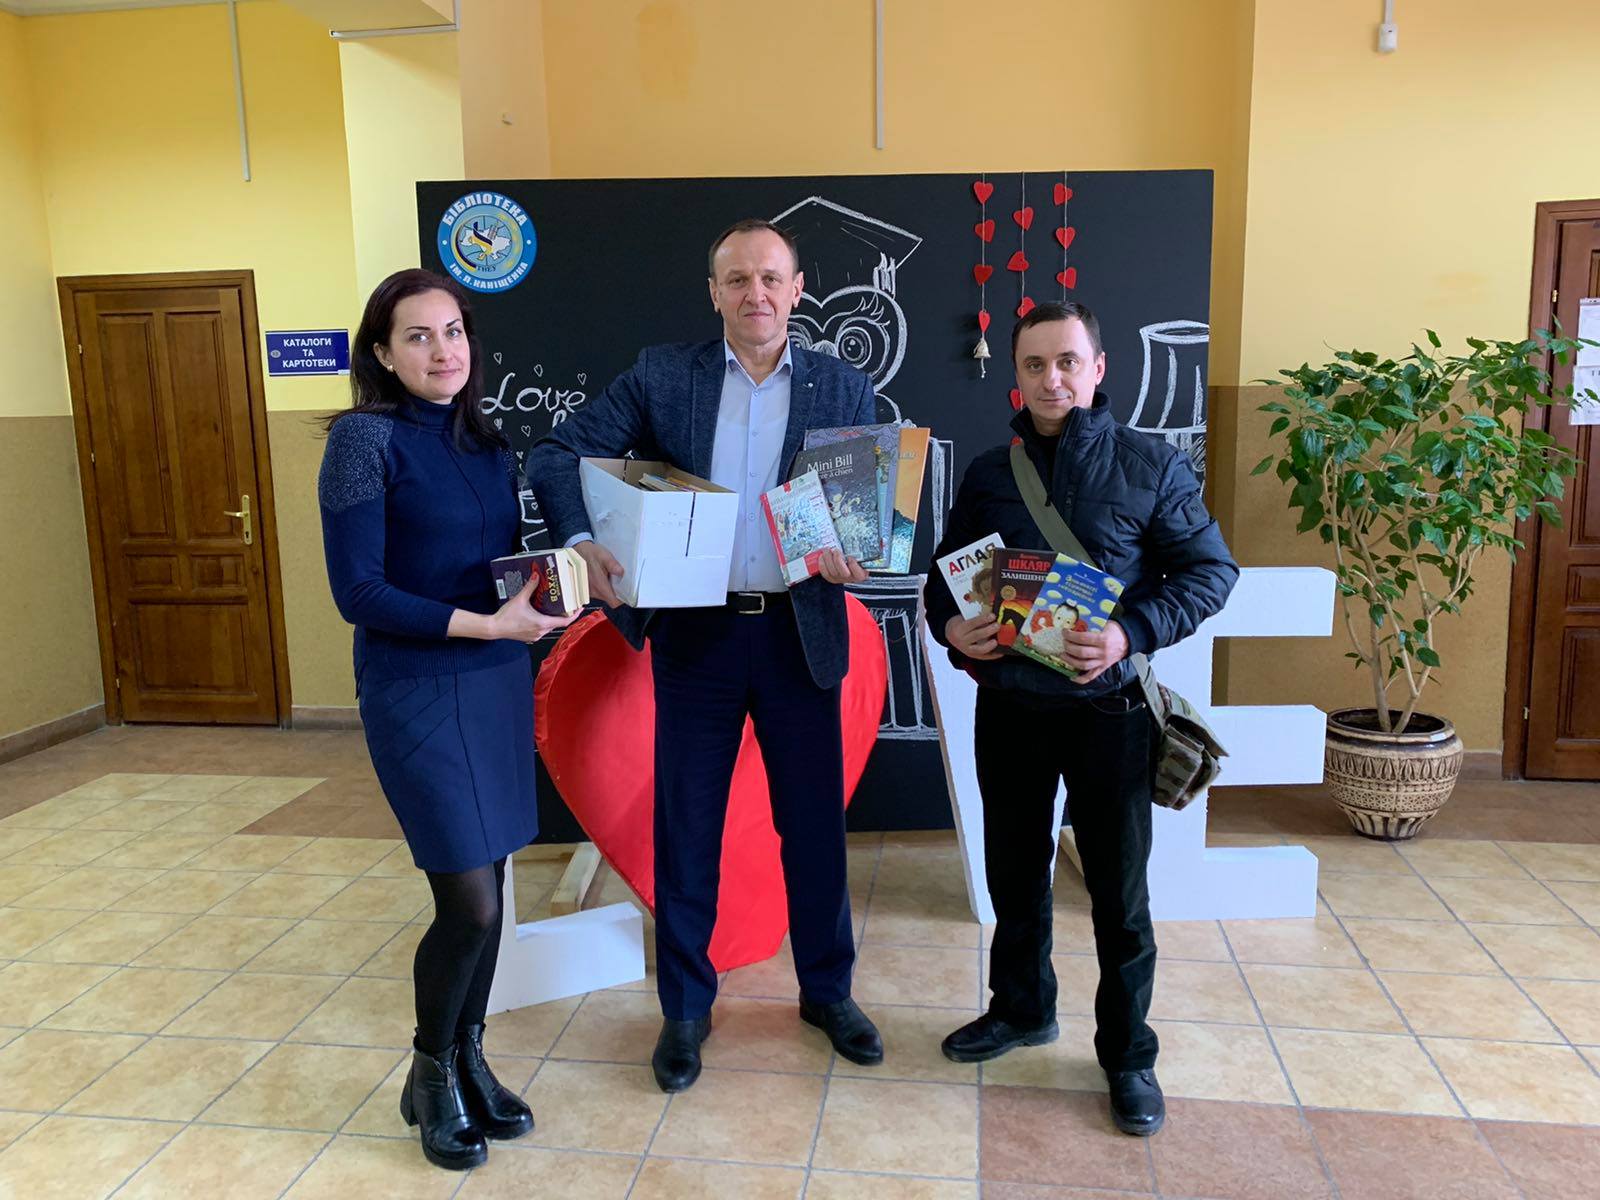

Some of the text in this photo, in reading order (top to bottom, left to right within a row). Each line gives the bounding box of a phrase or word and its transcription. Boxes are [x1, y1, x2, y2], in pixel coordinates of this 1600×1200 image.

[442, 194, 528, 226] БІБЛІОТЕКА
[283, 338, 332, 347] КАТАЛОГИ
[302, 349, 315, 357] ТА
[282, 359, 336, 368] КАРТОТЕКИ
[480, 372, 586, 415] Love
[808, 454, 852, 473] Mini Bill
[1008, 560, 1051, 572] ШКЛЯР
[1001, 572, 1046, 581] ЗАЛИШЕН
